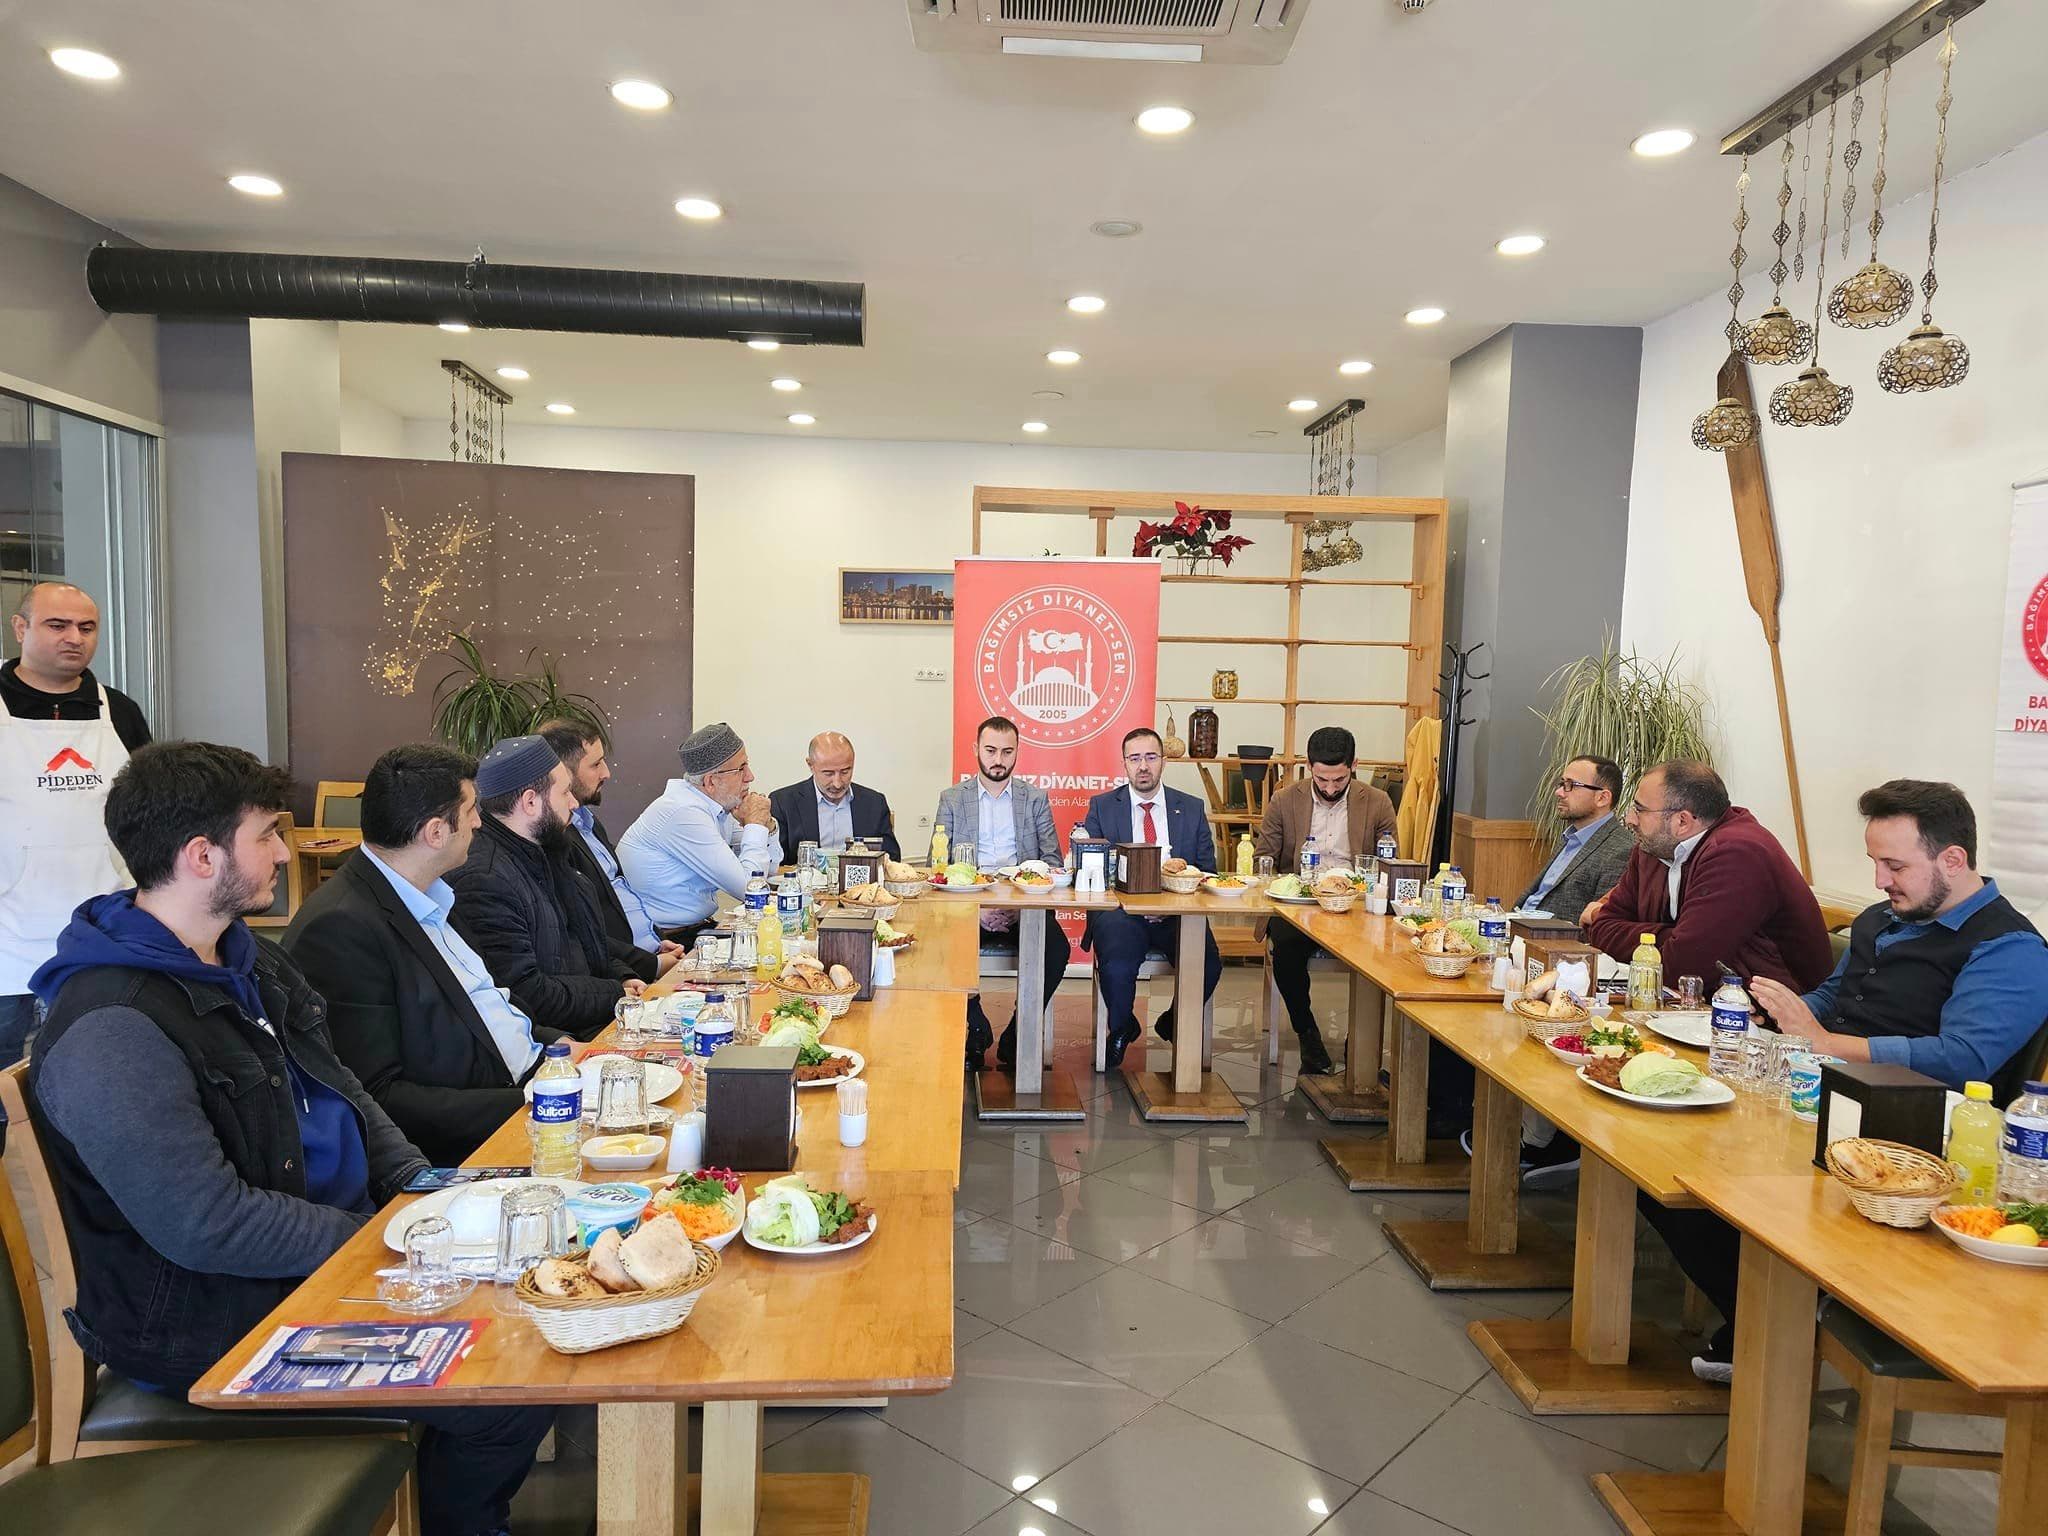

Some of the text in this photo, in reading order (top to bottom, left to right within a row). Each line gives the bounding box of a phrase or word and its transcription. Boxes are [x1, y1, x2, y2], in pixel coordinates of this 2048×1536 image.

[984, 592, 1126, 674] BAĞIMSIZ DİYANET-SEN
[1039, 710, 1067, 719] 2005
[37, 774, 103, 787] PİDEDEN
[1715, 1015, 1744, 1027] Sultan
[537, 1105, 572, 1117] Sultan
